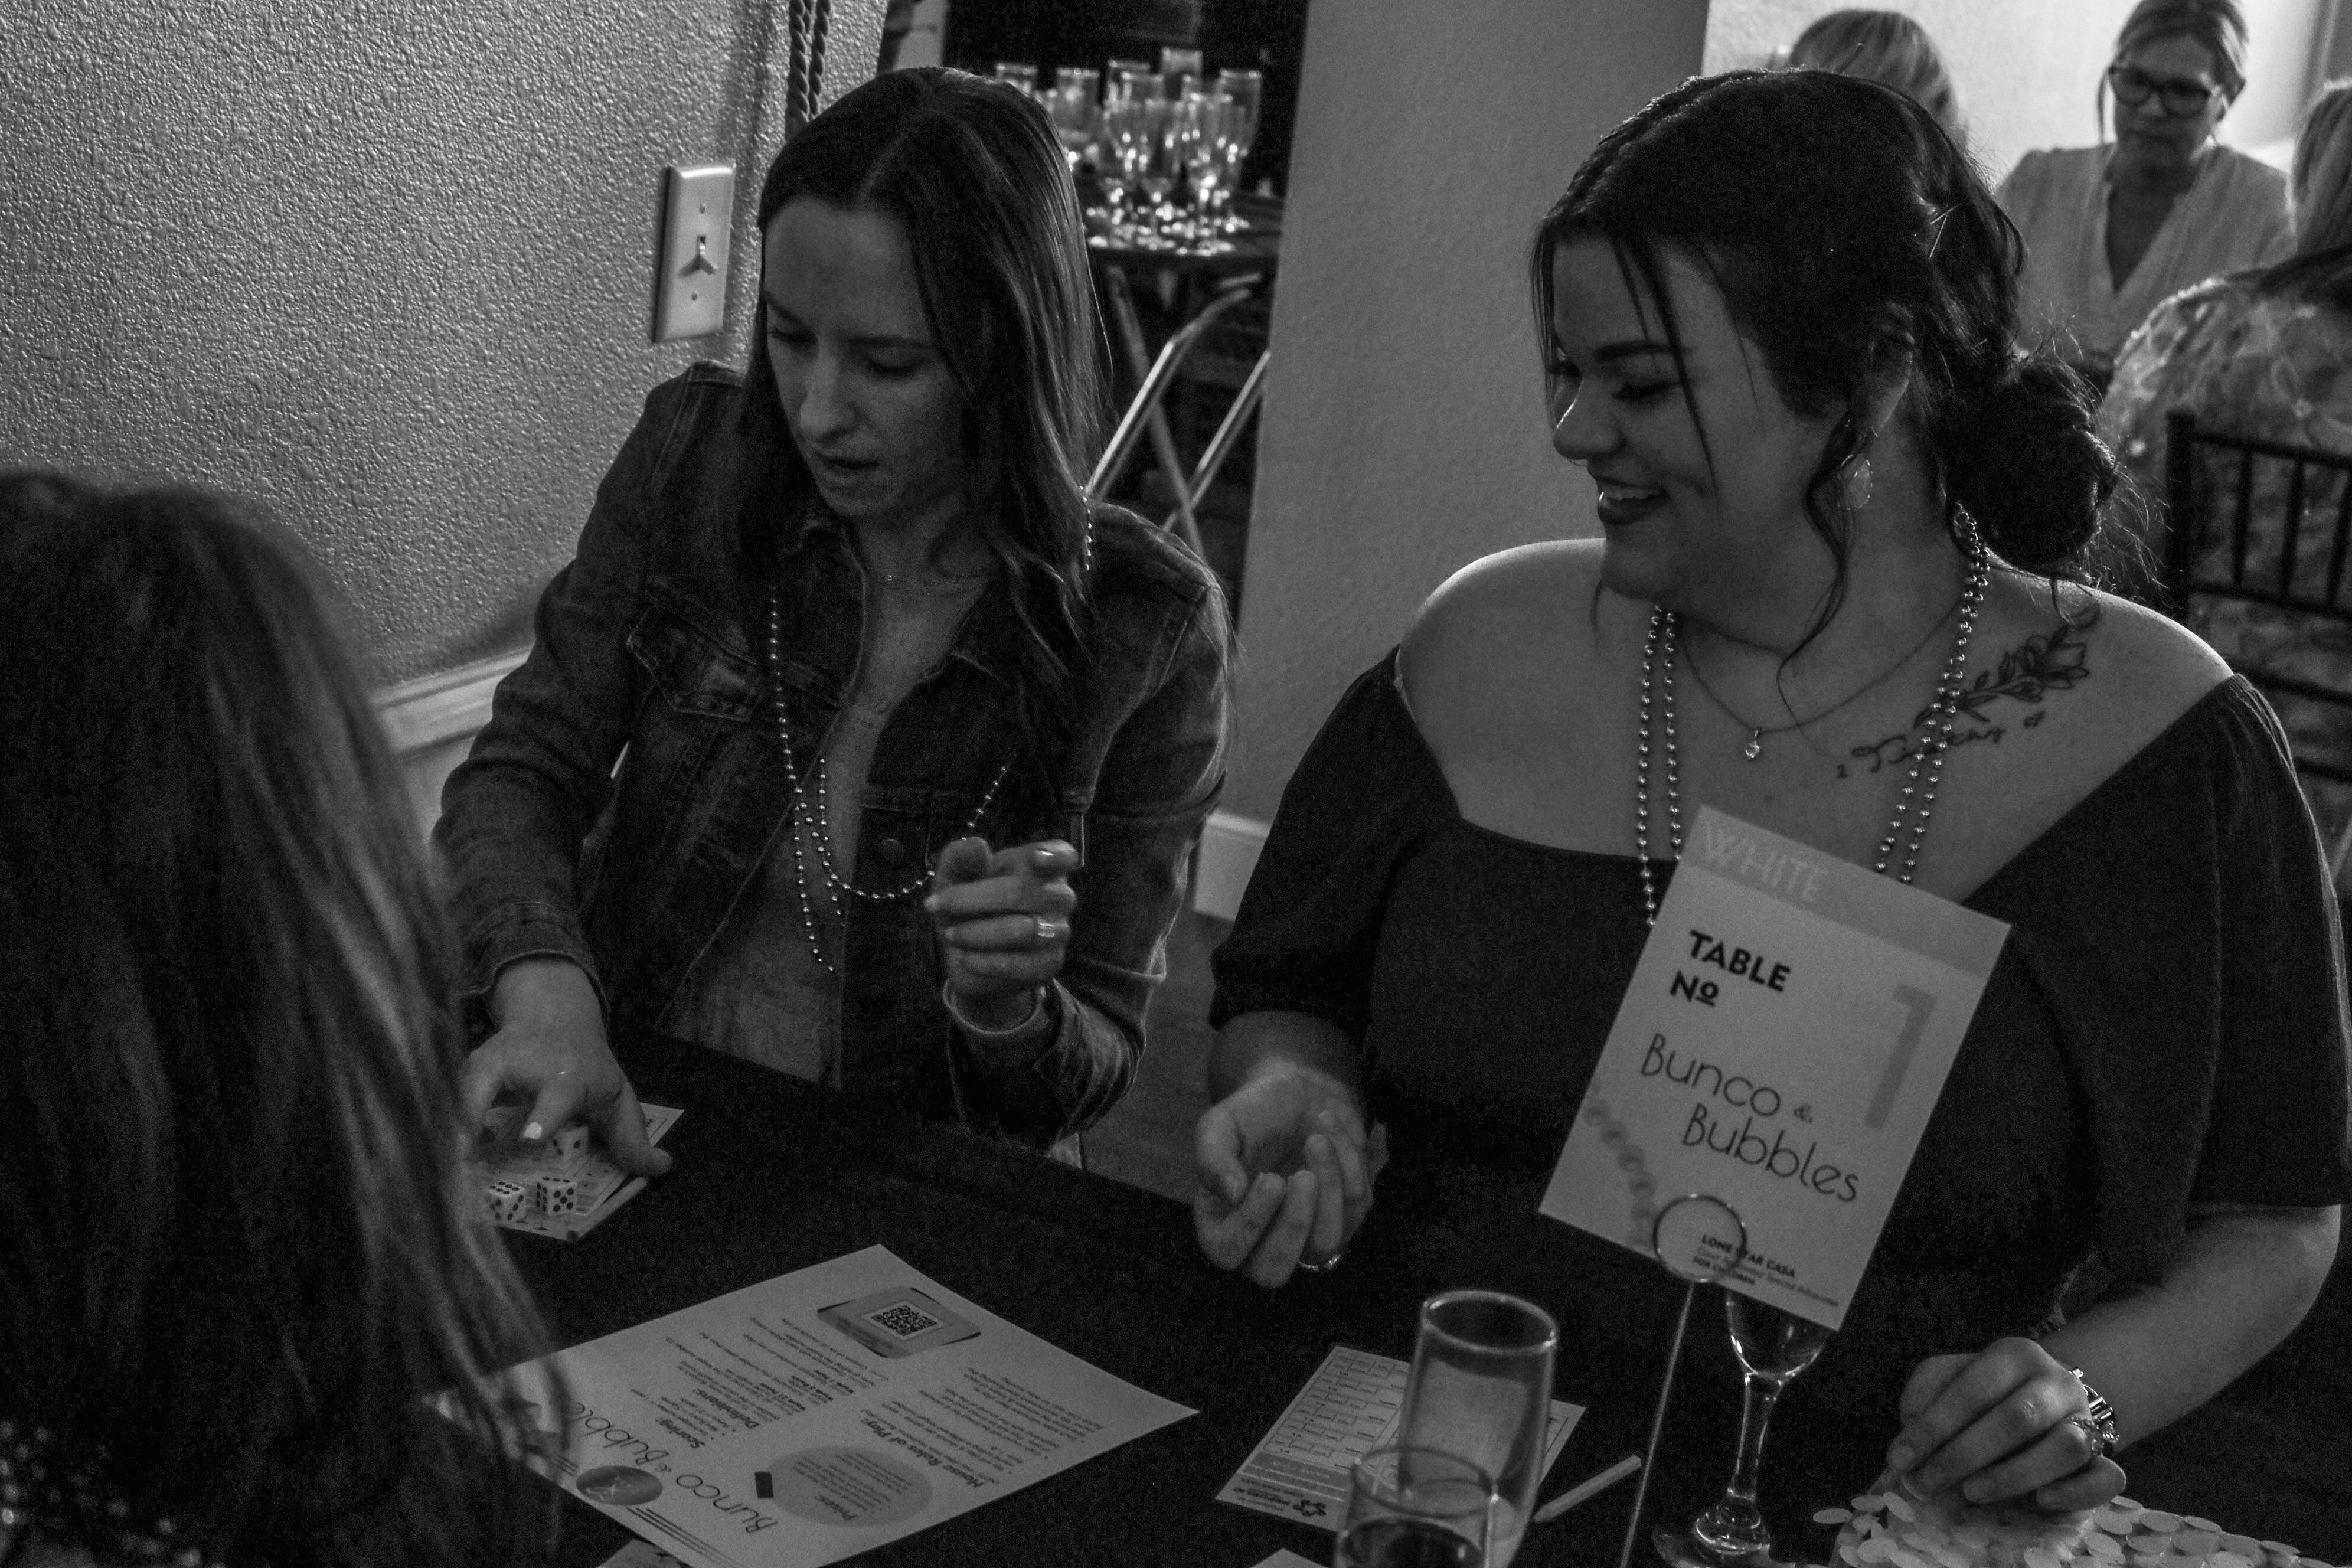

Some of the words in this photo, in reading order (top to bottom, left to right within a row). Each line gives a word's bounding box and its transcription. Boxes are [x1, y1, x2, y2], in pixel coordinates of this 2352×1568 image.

[1703, 822, 1830, 903] WHITE
[1689, 929, 1791, 992] TABLE
[1641, 1033, 1781, 1117] Bunco
[1793, 1103, 1814, 1123] &
[1683, 1102, 1858, 1203] Bubbles
[1701, 1234, 1733, 1253] LONE
[1766, 1259, 1795, 1278] CASA
[888, 1437, 907, 1446] of
[907, 1445, 943, 1466] Rules
[676, 1474, 778, 1533] Bunco
[943, 1464, 985, 1487] House
